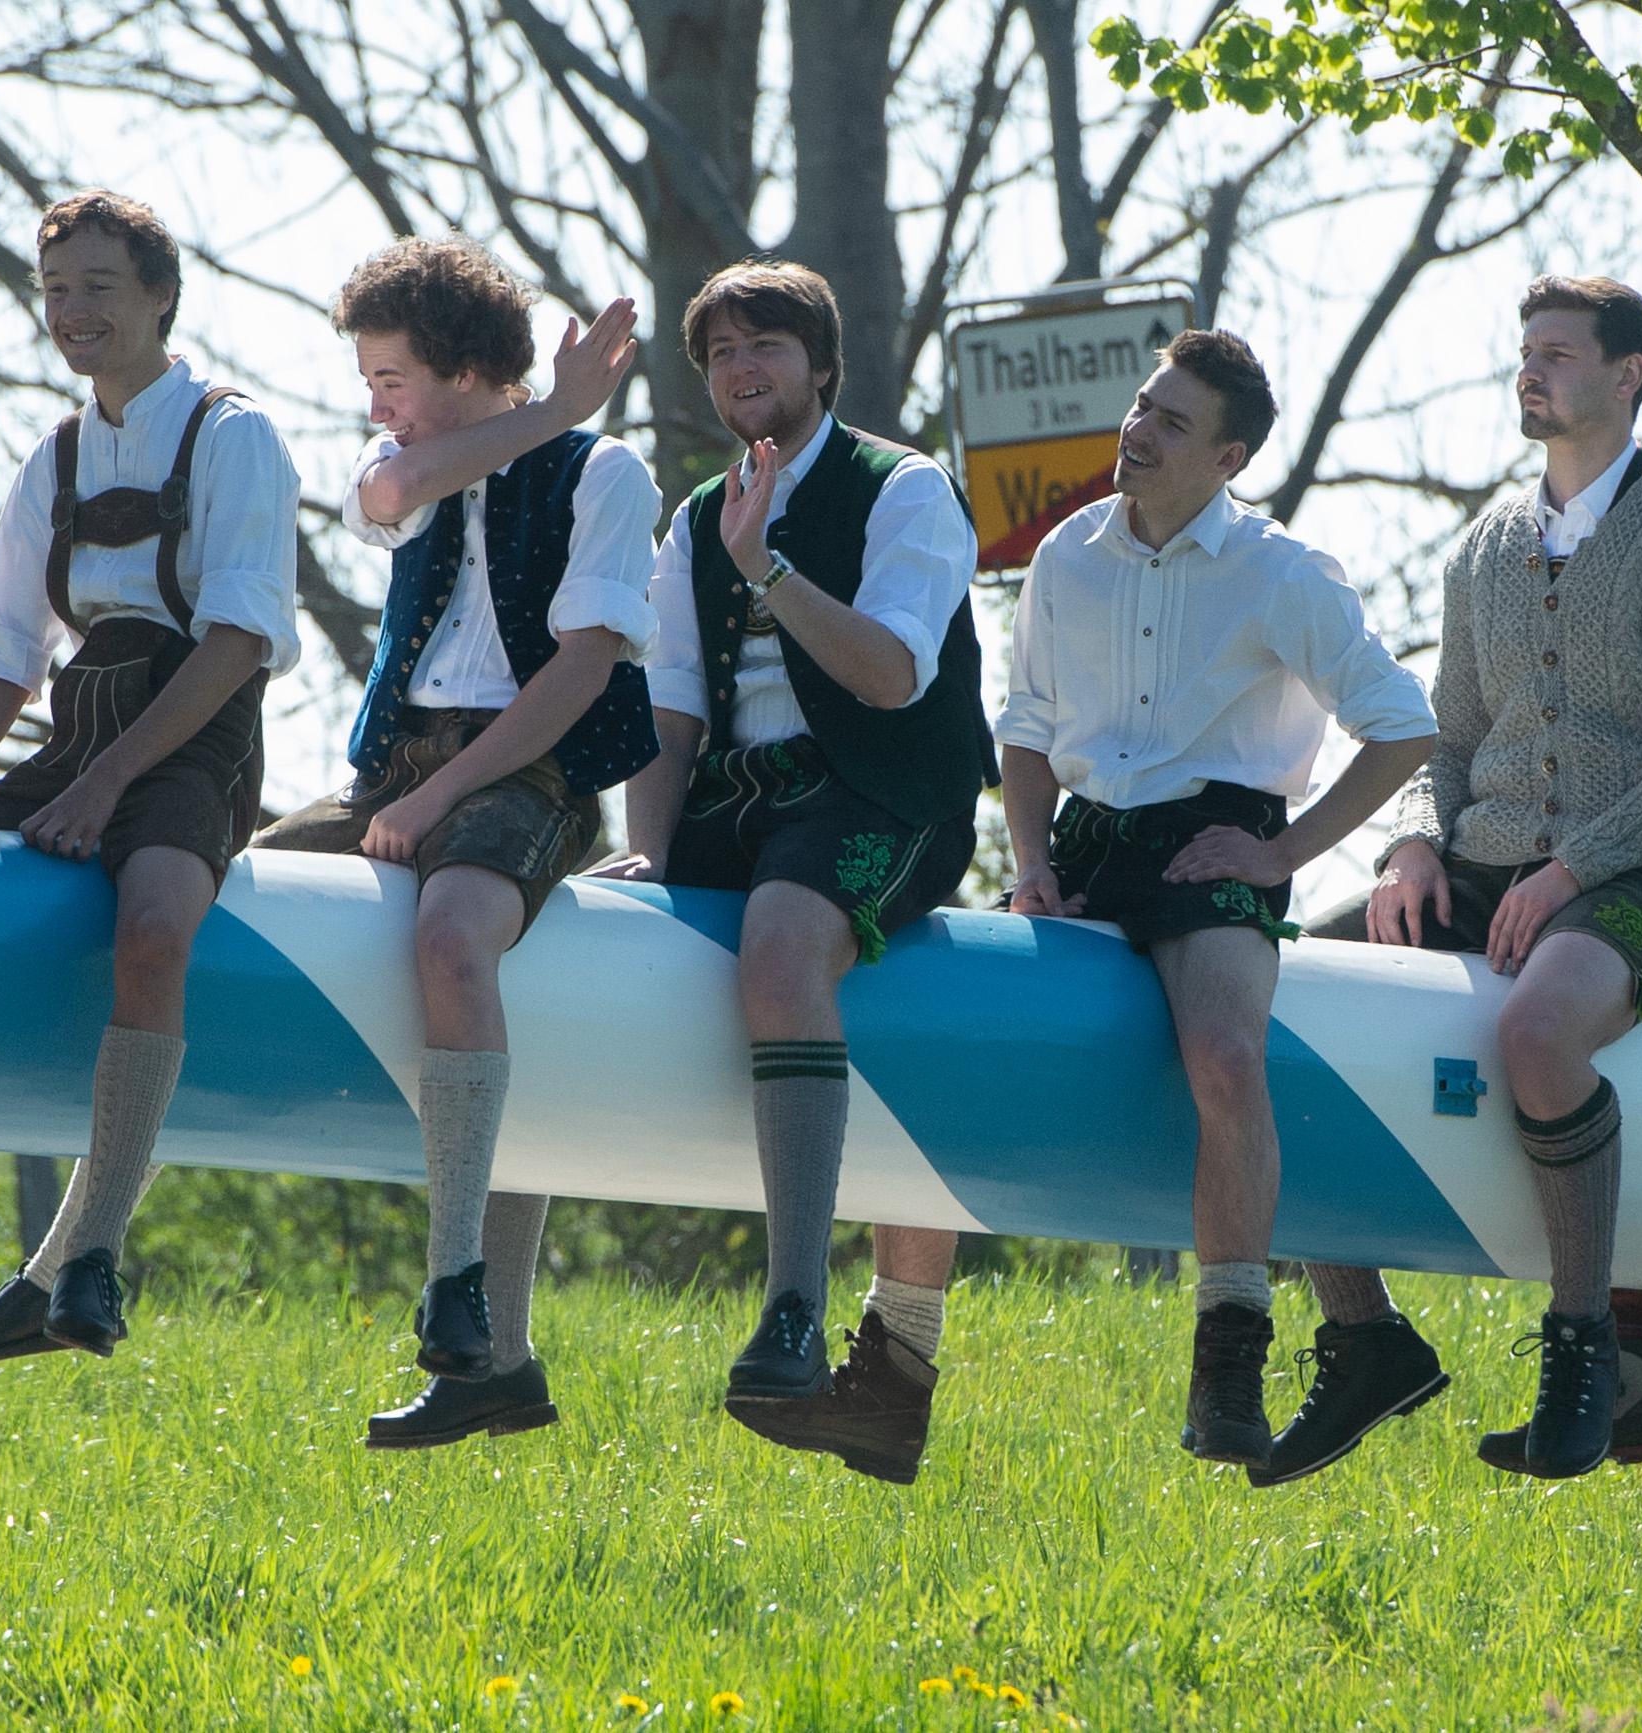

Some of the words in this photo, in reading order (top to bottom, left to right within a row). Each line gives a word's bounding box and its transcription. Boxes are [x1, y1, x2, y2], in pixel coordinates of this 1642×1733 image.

[966, 334, 1138, 392] Thalham
[1028, 400, 1042, 430] 3
[1049, 398, 1084, 425] km
